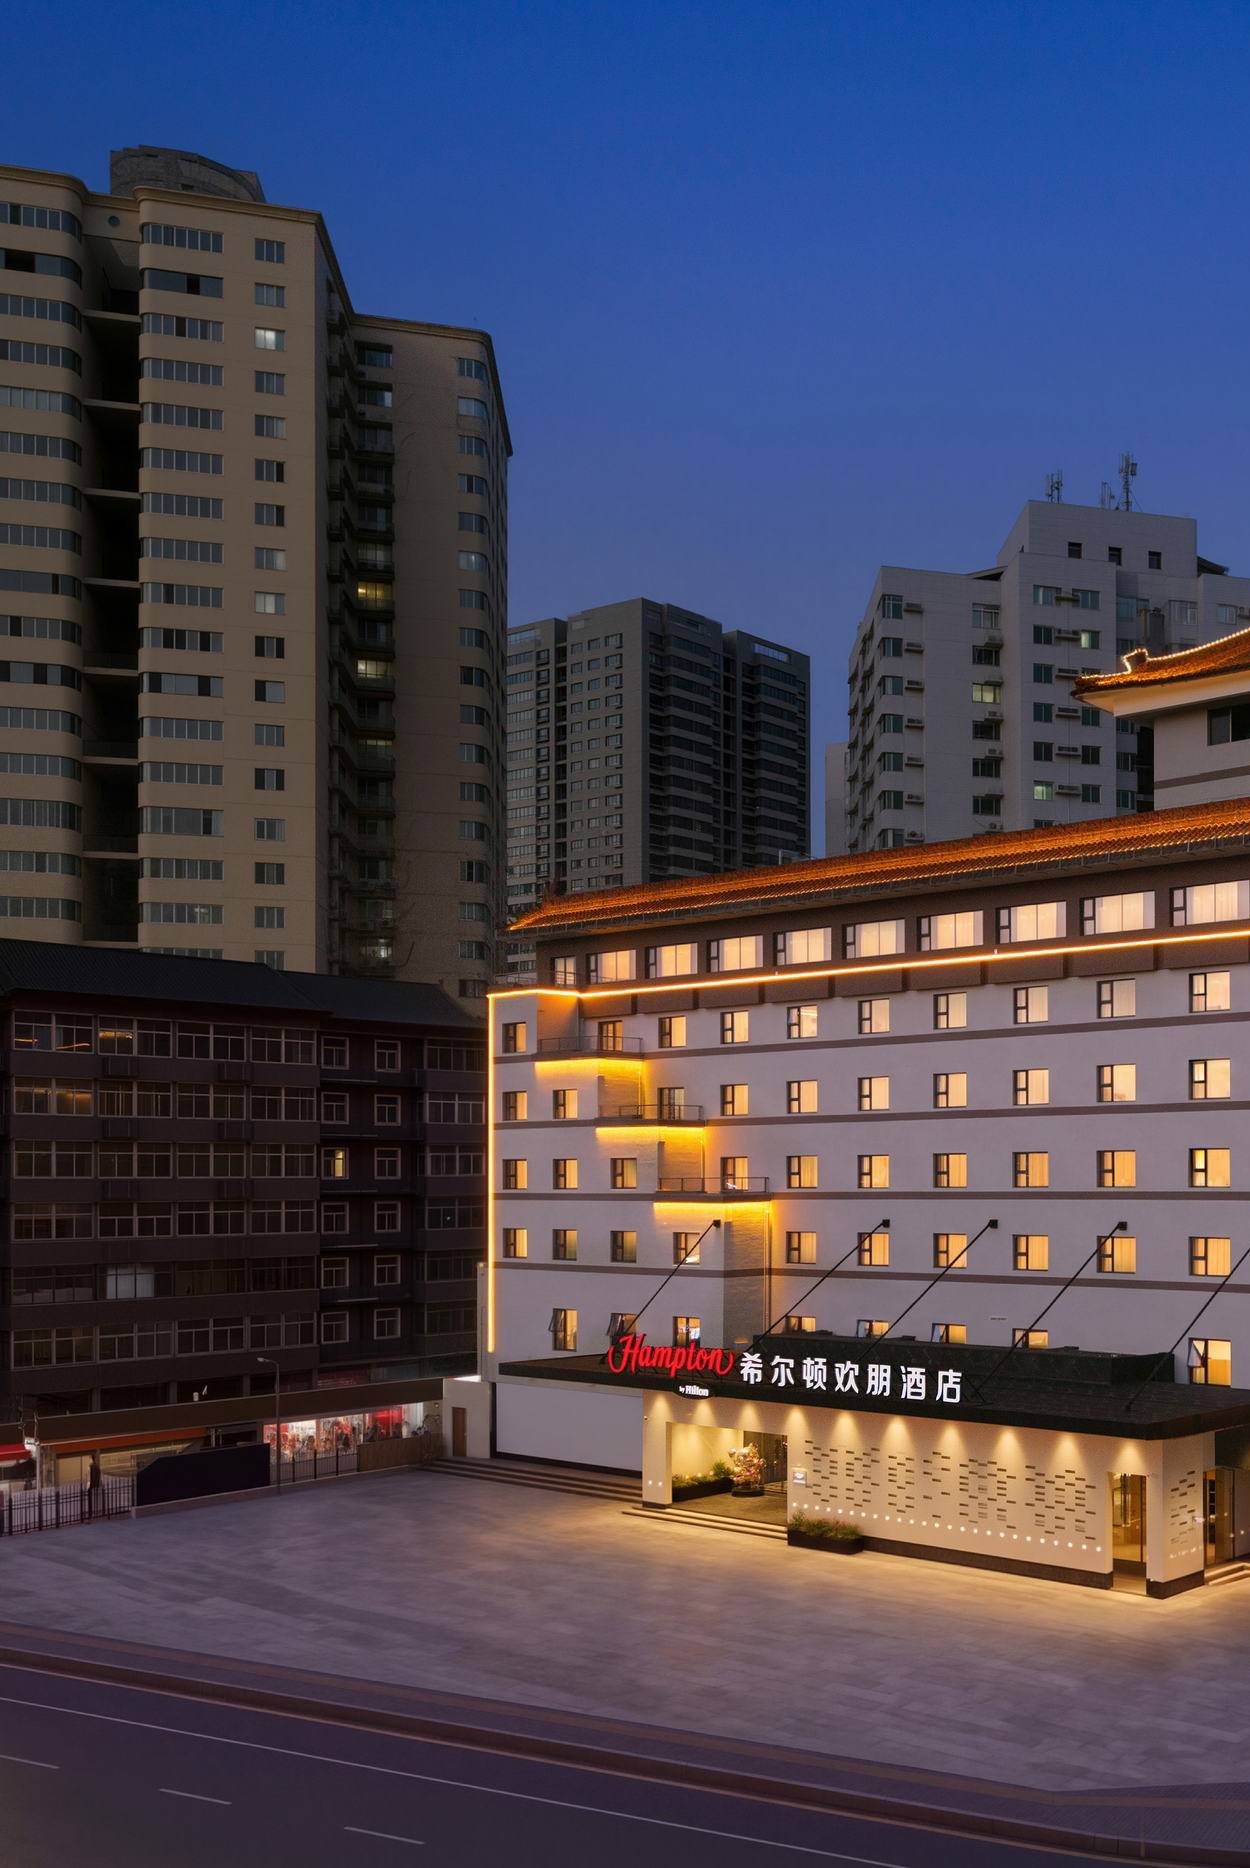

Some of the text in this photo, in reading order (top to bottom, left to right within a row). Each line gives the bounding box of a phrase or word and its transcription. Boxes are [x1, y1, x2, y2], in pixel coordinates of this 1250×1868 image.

[608, 1333, 734, 1378] Hampton
[739, 1352, 963, 1404] 希尔顿欢朋酒店
[685, 1385, 709, 1397] Hilton
